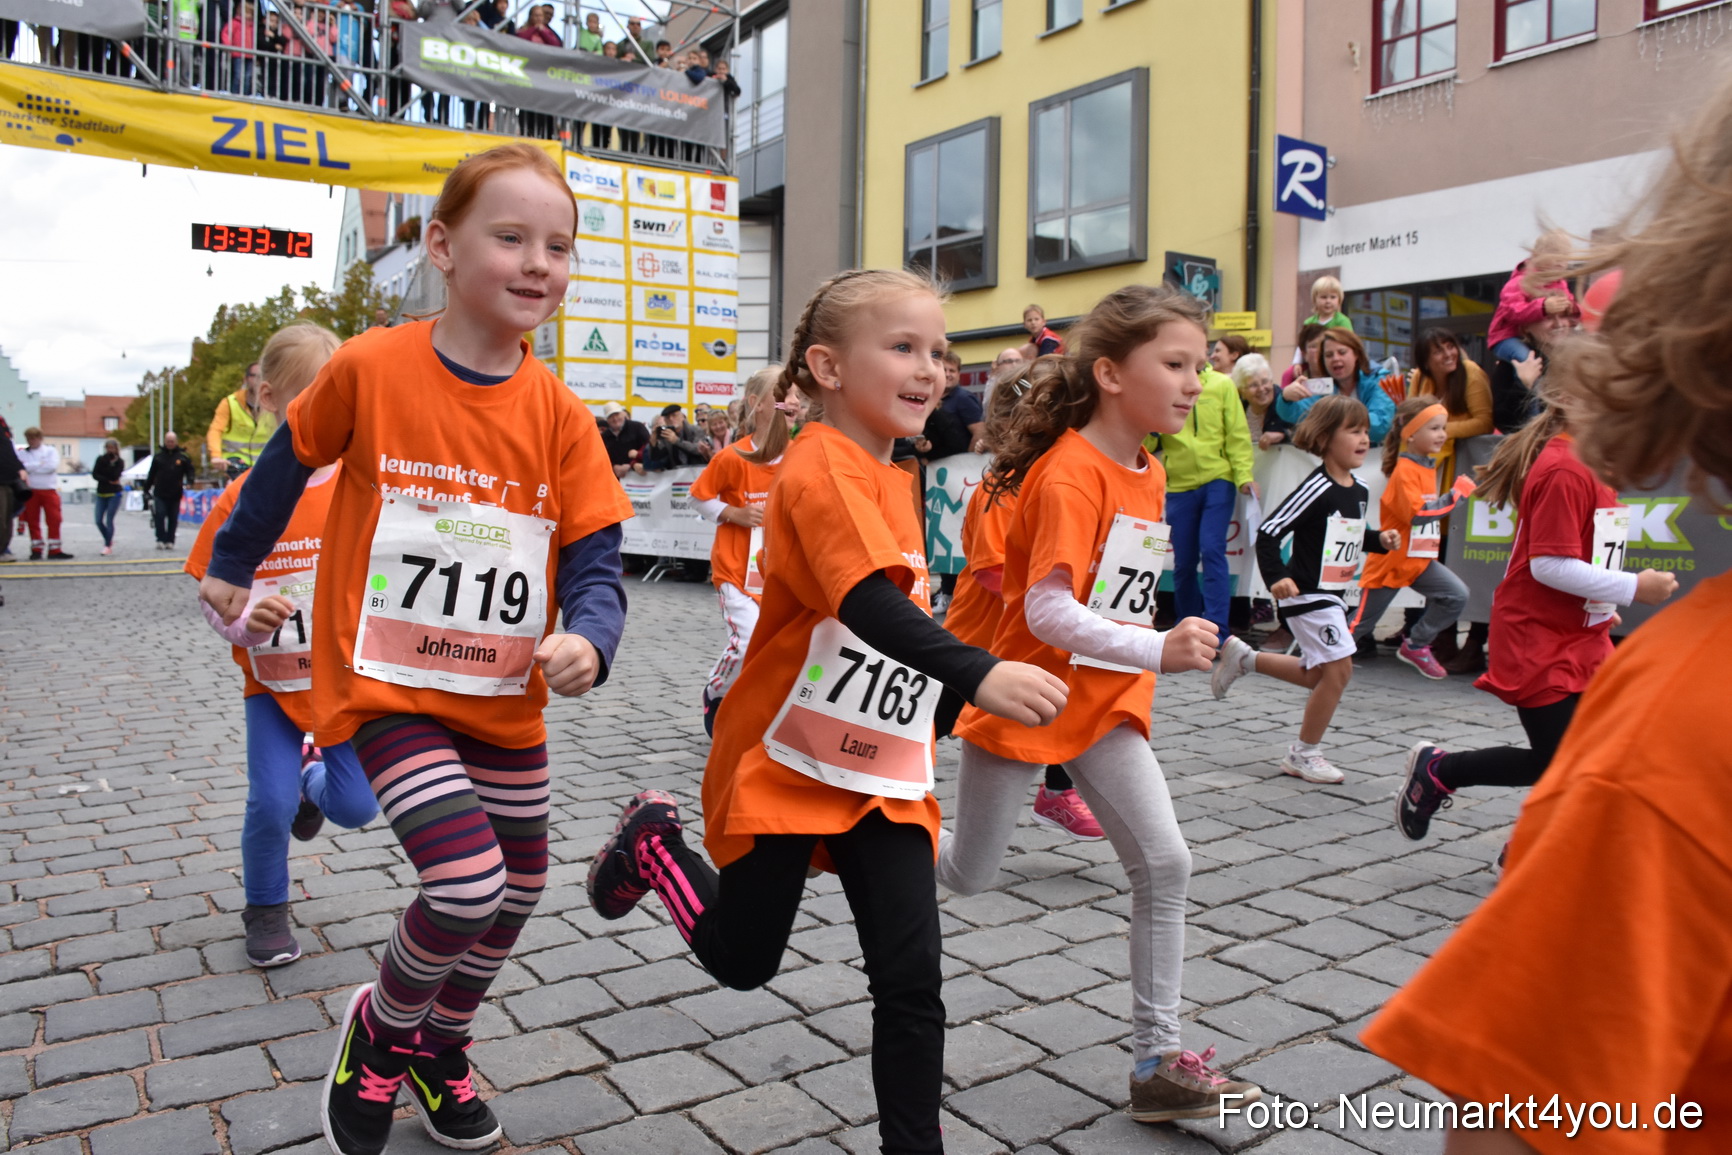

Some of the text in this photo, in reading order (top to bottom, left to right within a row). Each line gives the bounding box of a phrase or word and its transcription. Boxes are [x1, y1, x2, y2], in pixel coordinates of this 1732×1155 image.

[420, 36, 533, 81] BOCK
[547, 66, 591, 86] OFFICE
[594, 77, 657, 98] INDUSTRY
[660, 88, 709, 110] LOUNGE
[574, 89, 688, 121] www.bockonline.de
[60, 116, 126, 135] Stadtlauf
[211, 115, 350, 170] ZIEL
[633, 218, 667, 233] swn
[1326, 230, 1419, 258] Unterer Markt 15
[583, 296, 623, 308] VARIOTEC
[371, 597, 385, 609] B1
[400, 553, 530, 625] 7119
[416, 635, 497, 663] Johanna
[799, 687, 813, 700] B1
[826, 645, 928, 726] 7163
[840, 732, 879, 760] Laura
